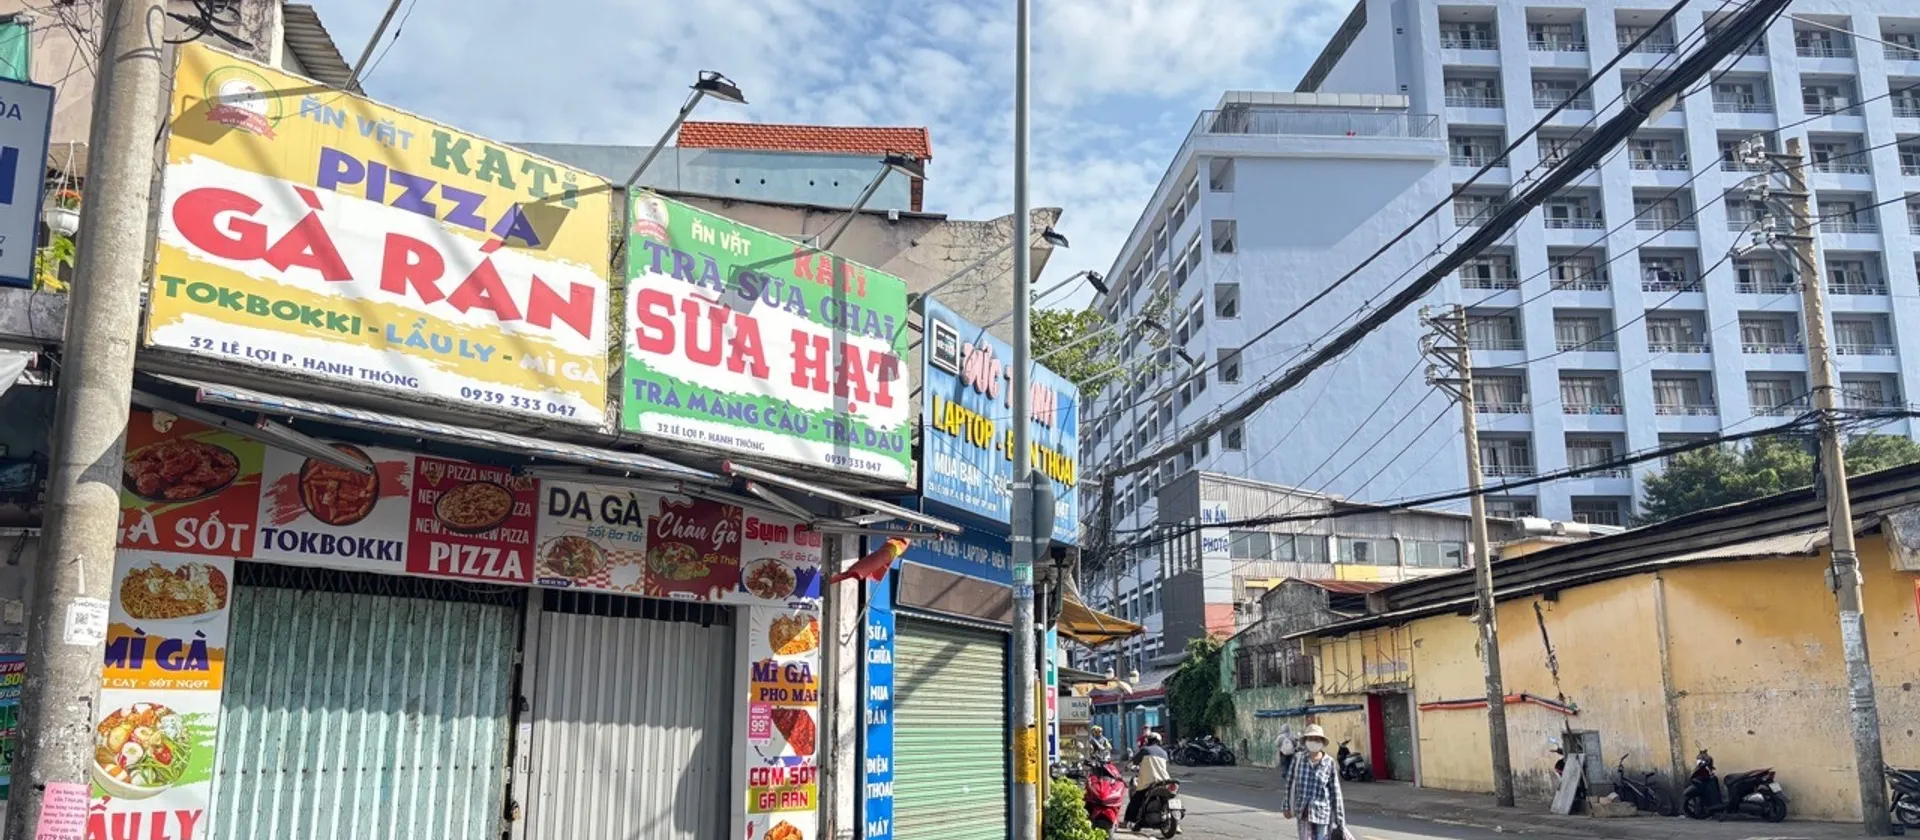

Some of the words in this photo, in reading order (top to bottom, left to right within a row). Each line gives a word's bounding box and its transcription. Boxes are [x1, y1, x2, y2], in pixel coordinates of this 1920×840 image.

[300, 96, 346, 129] ĂN
[356, 115, 414, 150] VẶT
[316, 146, 541, 247] PIZZA
[691, 217, 715, 246] ĂN
[720, 230, 751, 257] VẶT
[172, 185, 354, 282] GÀ
[380, 232, 595, 341] RÁN
[160, 275, 361, 335] TOKBOKKI
[386, 317, 453, 354] LẨU
[459, 339, 496, 362] LY
[519, 351, 555, 377] MÌ
[561, 357, 601, 385] GÀ
[189, 336, 214, 350] 32
[221, 340, 240, 355] LÊ
[246, 346, 276, 362] LỢI
[282, 353, 297, 366] P.
[359, 367, 419, 389] THÔNG
[790, 329, 900, 413] HẠT
[460, 386, 504, 404] 0939
[510, 395, 541, 411] 333
[547, 402, 576, 417] 047
[632, 378, 681, 409] TRÀ
[763, 399, 809, 434] CẦU
[823, 419, 860, 444] TRÀ
[864, 424, 904, 453] DÂU
[657, 422, 669, 433] 32
[671, 424, 680, 435] LÊ
[933, 395, 995, 450] LAPTOP
[421, 461, 445, 478] NEW
[447, 465, 477, 481] PIZZA
[480, 469, 502, 483] NEW
[825, 453, 847, 466] 0939
[849, 458, 864, 469] 333
[866, 460, 882, 472] 047
[935, 452, 957, 478] MUA
[548, 486, 593, 521] DA
[600, 492, 644, 528] GÀ
[1203, 509, 1211, 523] IN
[175, 510, 250, 552] SỐT
[261, 527, 403, 562] TOKBOKKI
[415, 517, 440, 534] NEW
[501, 528, 530, 544] PIZZA
[656, 511, 709, 540] Chân
[711, 519, 739, 551] Gà
[745, 516, 789, 546] Sụn
[428, 541, 524, 579] PIZZA
[104, 627, 147, 669] MÌ
[155, 629, 210, 671] GÀ
[112, 678, 138, 688] CAY
[760, 687, 788, 701] PHO
[870, 686, 889, 700] MUA
[867, 706, 887, 724] BÁN
[750, 766, 784, 786] CƠM
[789, 757, 817, 785] SỐT
[151, 808, 202, 840] LY
[868, 816, 889, 838] MÁY
